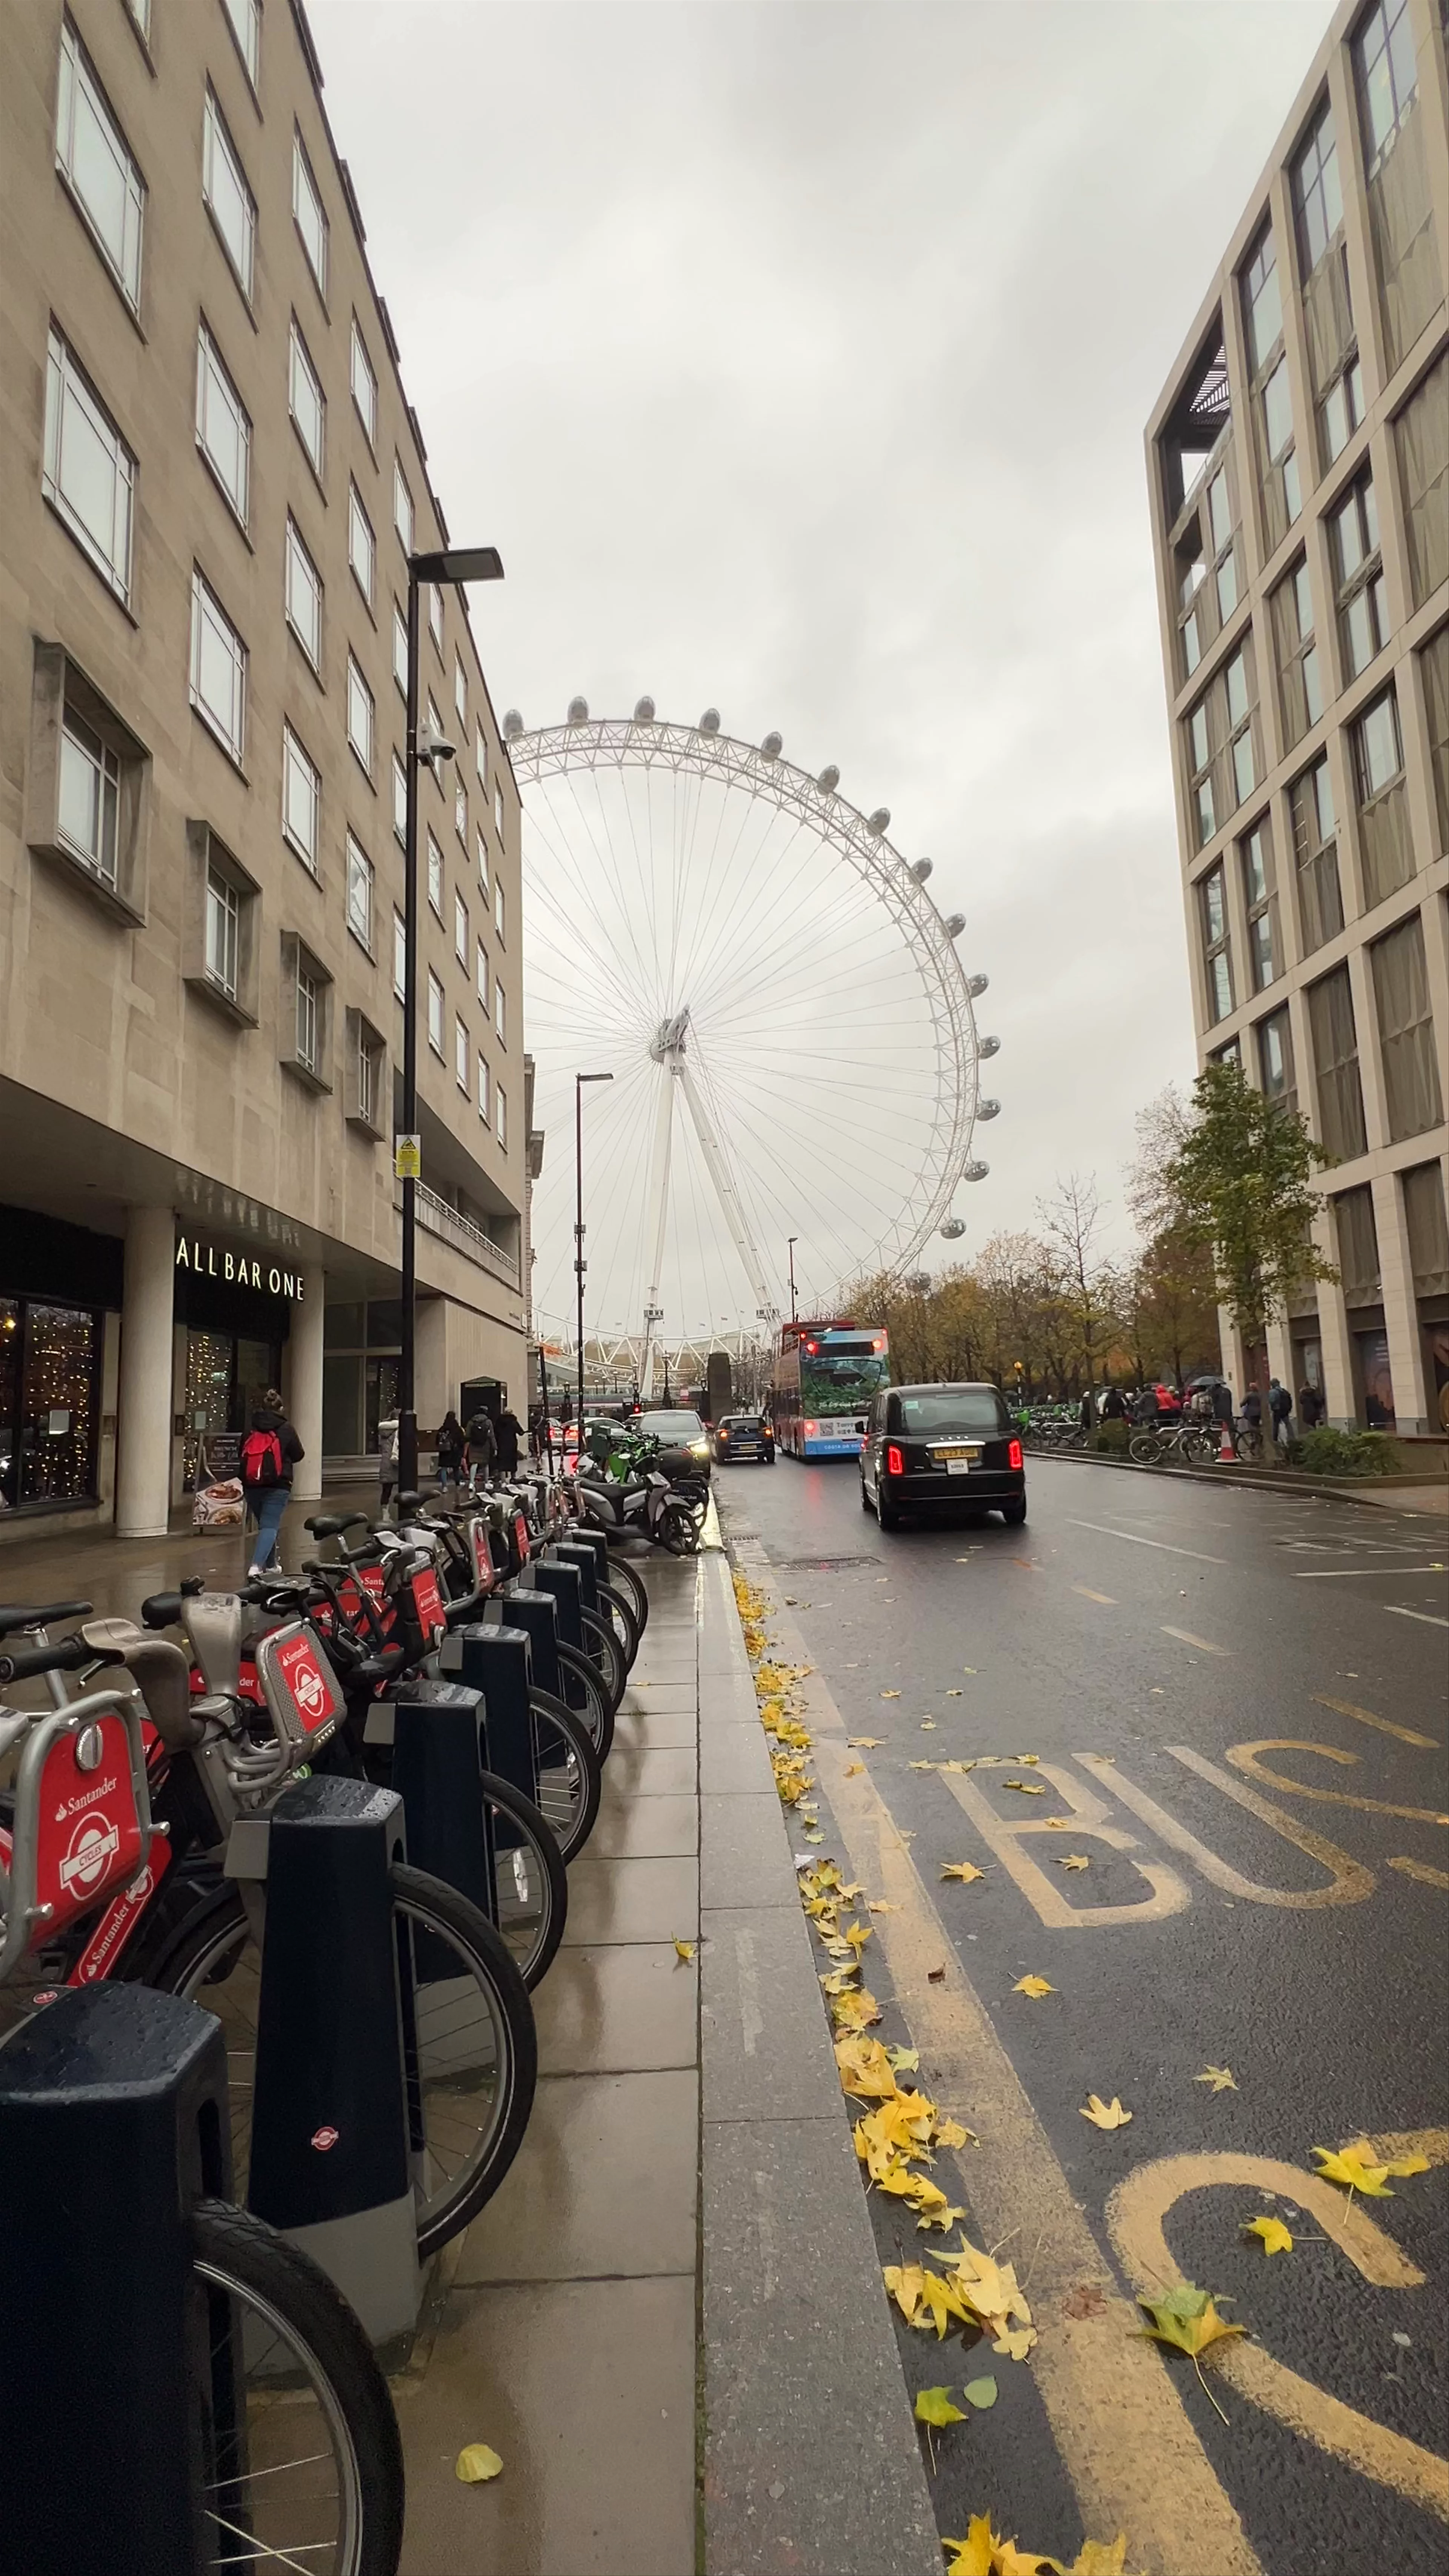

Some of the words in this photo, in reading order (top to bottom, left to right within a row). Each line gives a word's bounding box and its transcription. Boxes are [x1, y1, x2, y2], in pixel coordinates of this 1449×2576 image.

[176, 1237, 217, 1276] ALL
[225, 1253, 261, 1289] BAR
[269, 1269, 304, 1301] ONE
[68, 1777, 117, 1815] Santander
[79, 1845, 102, 1866] CYCLES
[938, 1739, 1449, 1928] BUS
[92, 1904, 129, 1964] Santander
